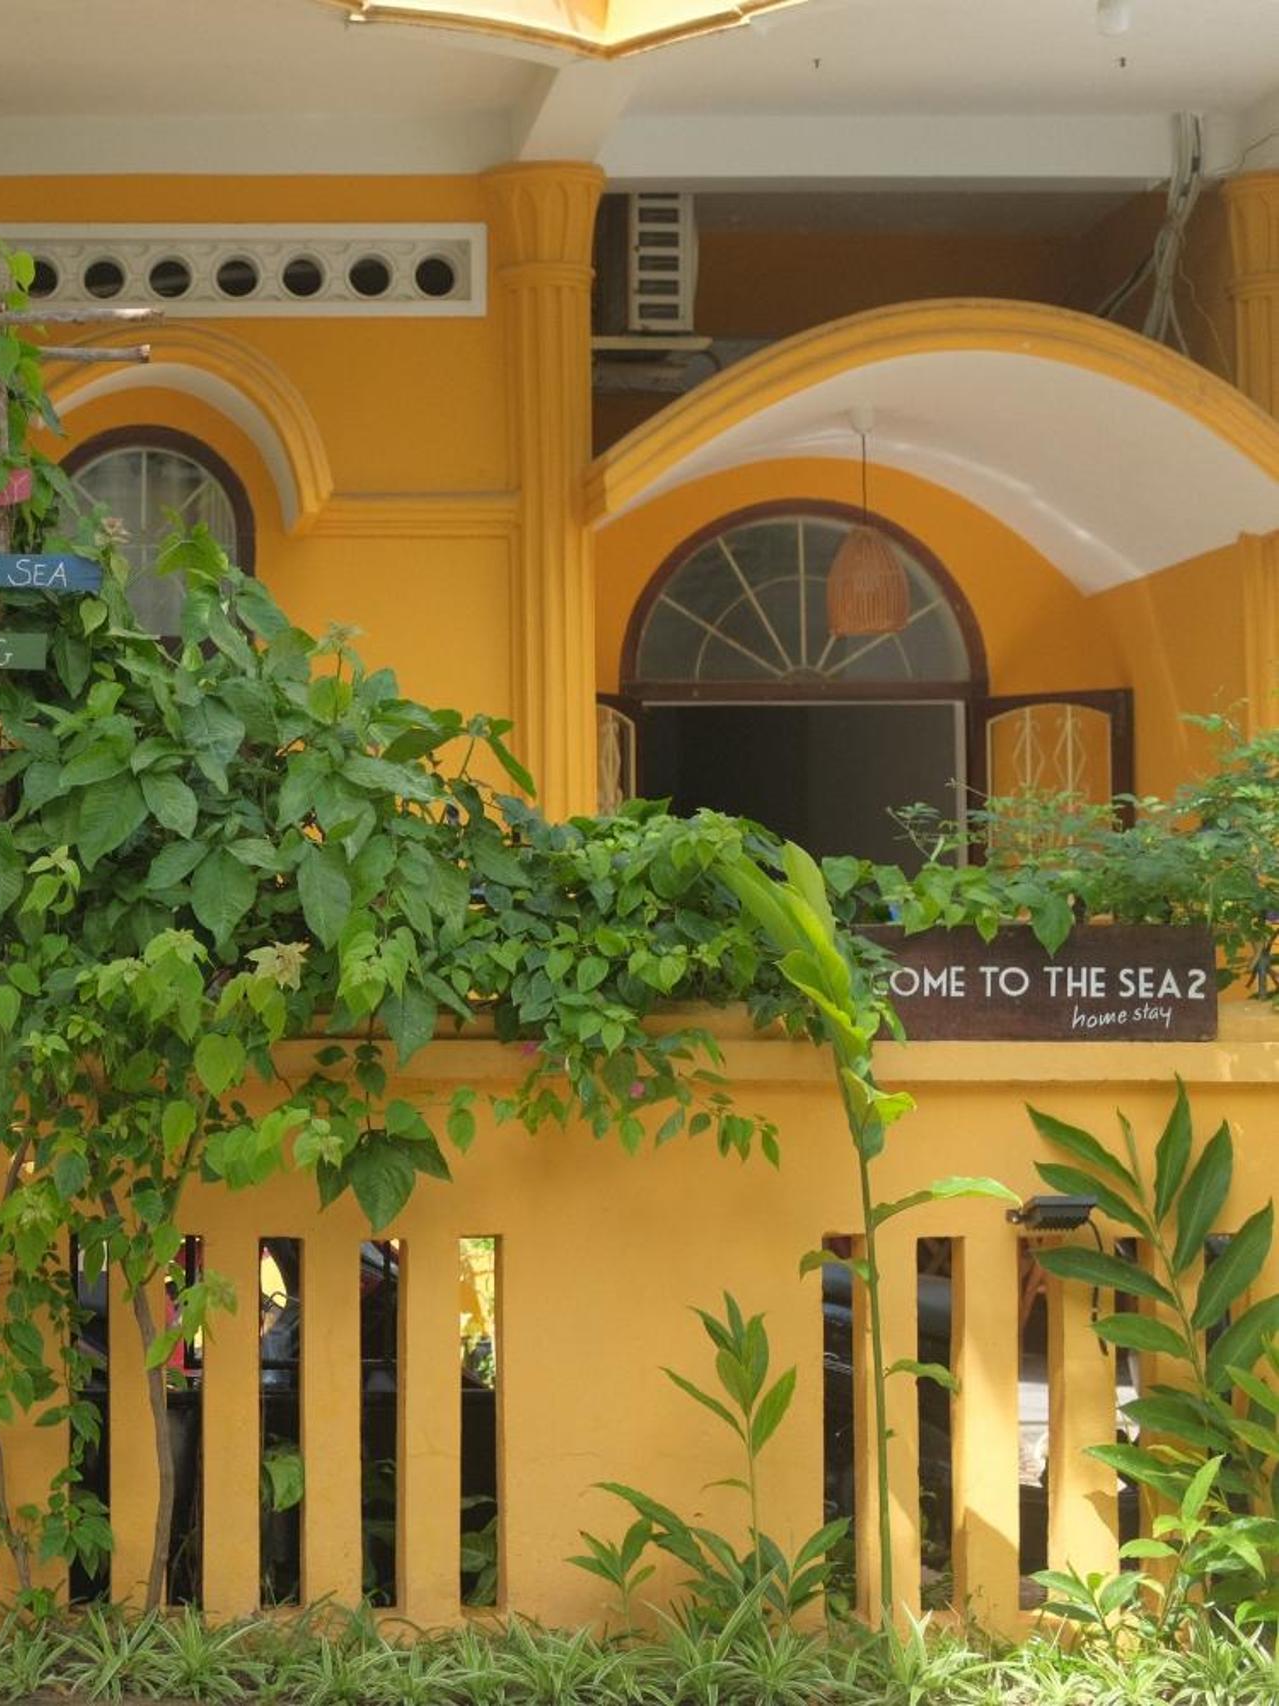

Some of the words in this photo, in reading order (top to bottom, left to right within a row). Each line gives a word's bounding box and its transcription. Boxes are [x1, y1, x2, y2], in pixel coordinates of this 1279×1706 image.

[7, 559, 68, 588] SEA
[978, 966, 1030, 997] TO
[1043, 966, 1106, 998] THE
